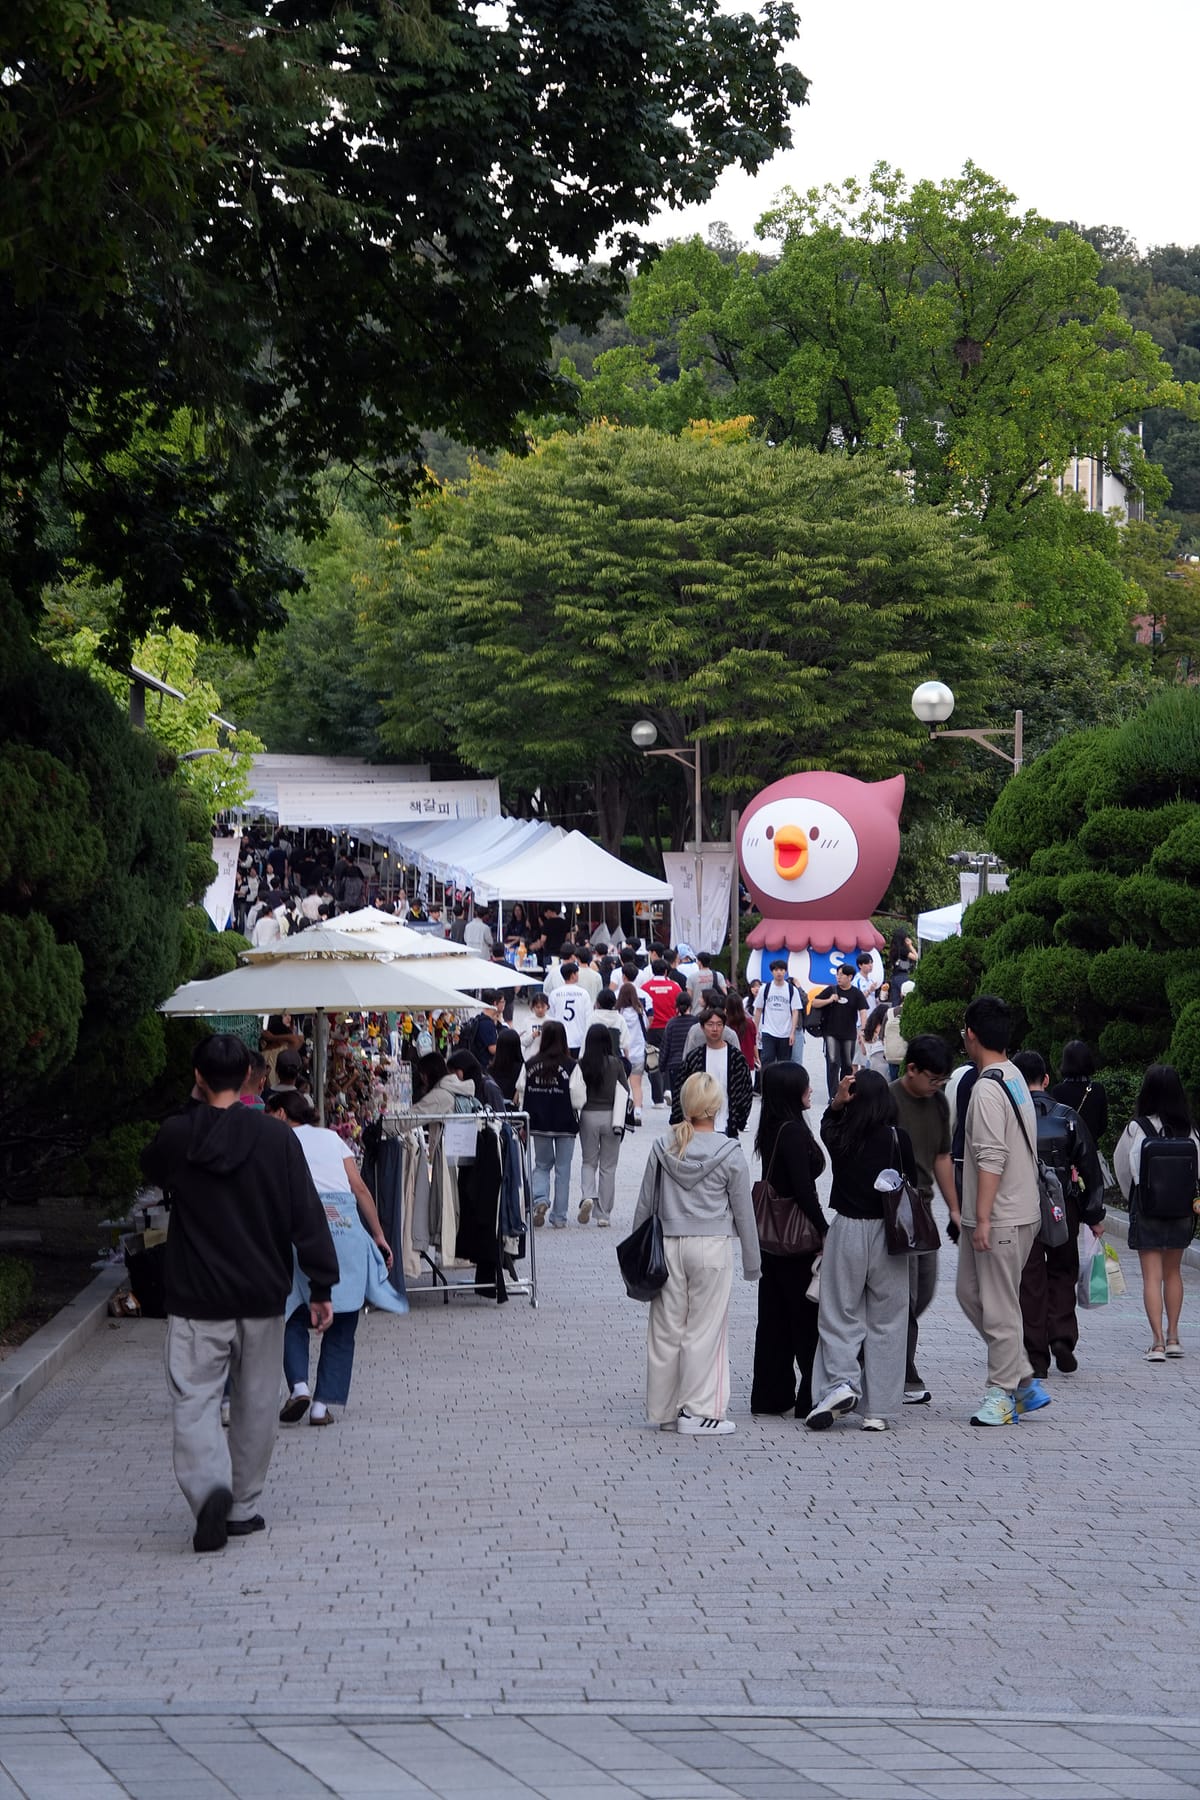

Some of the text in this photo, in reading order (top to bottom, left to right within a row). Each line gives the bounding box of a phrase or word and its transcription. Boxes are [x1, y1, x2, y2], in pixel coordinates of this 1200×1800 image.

[410, 798, 450, 815] 책갈피
[829, 951, 846, 975] S
[563, 1000, 576, 1021] 5
